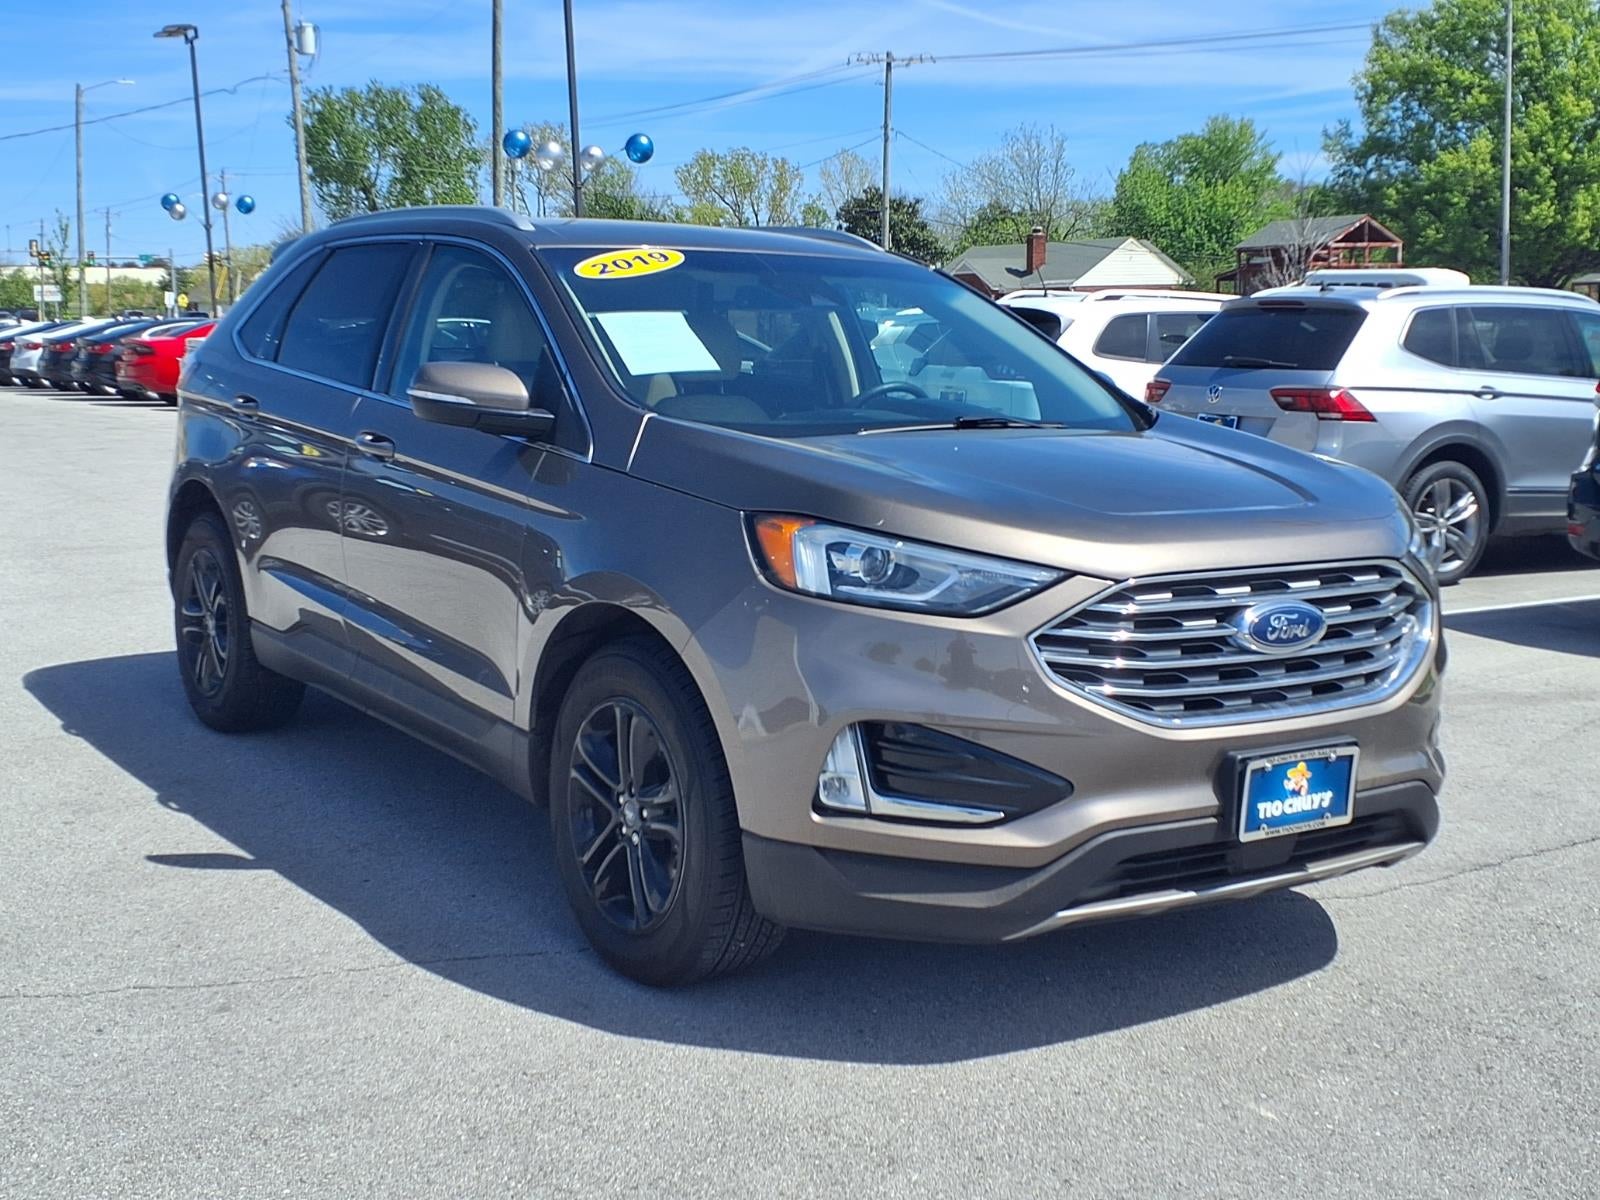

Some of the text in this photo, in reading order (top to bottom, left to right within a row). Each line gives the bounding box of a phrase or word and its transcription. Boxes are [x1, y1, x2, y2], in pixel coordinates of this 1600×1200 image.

[591, 252, 669, 275] 2019
[1266, 613, 1310, 640] Ford
[1257, 799, 1283, 819] TIO
